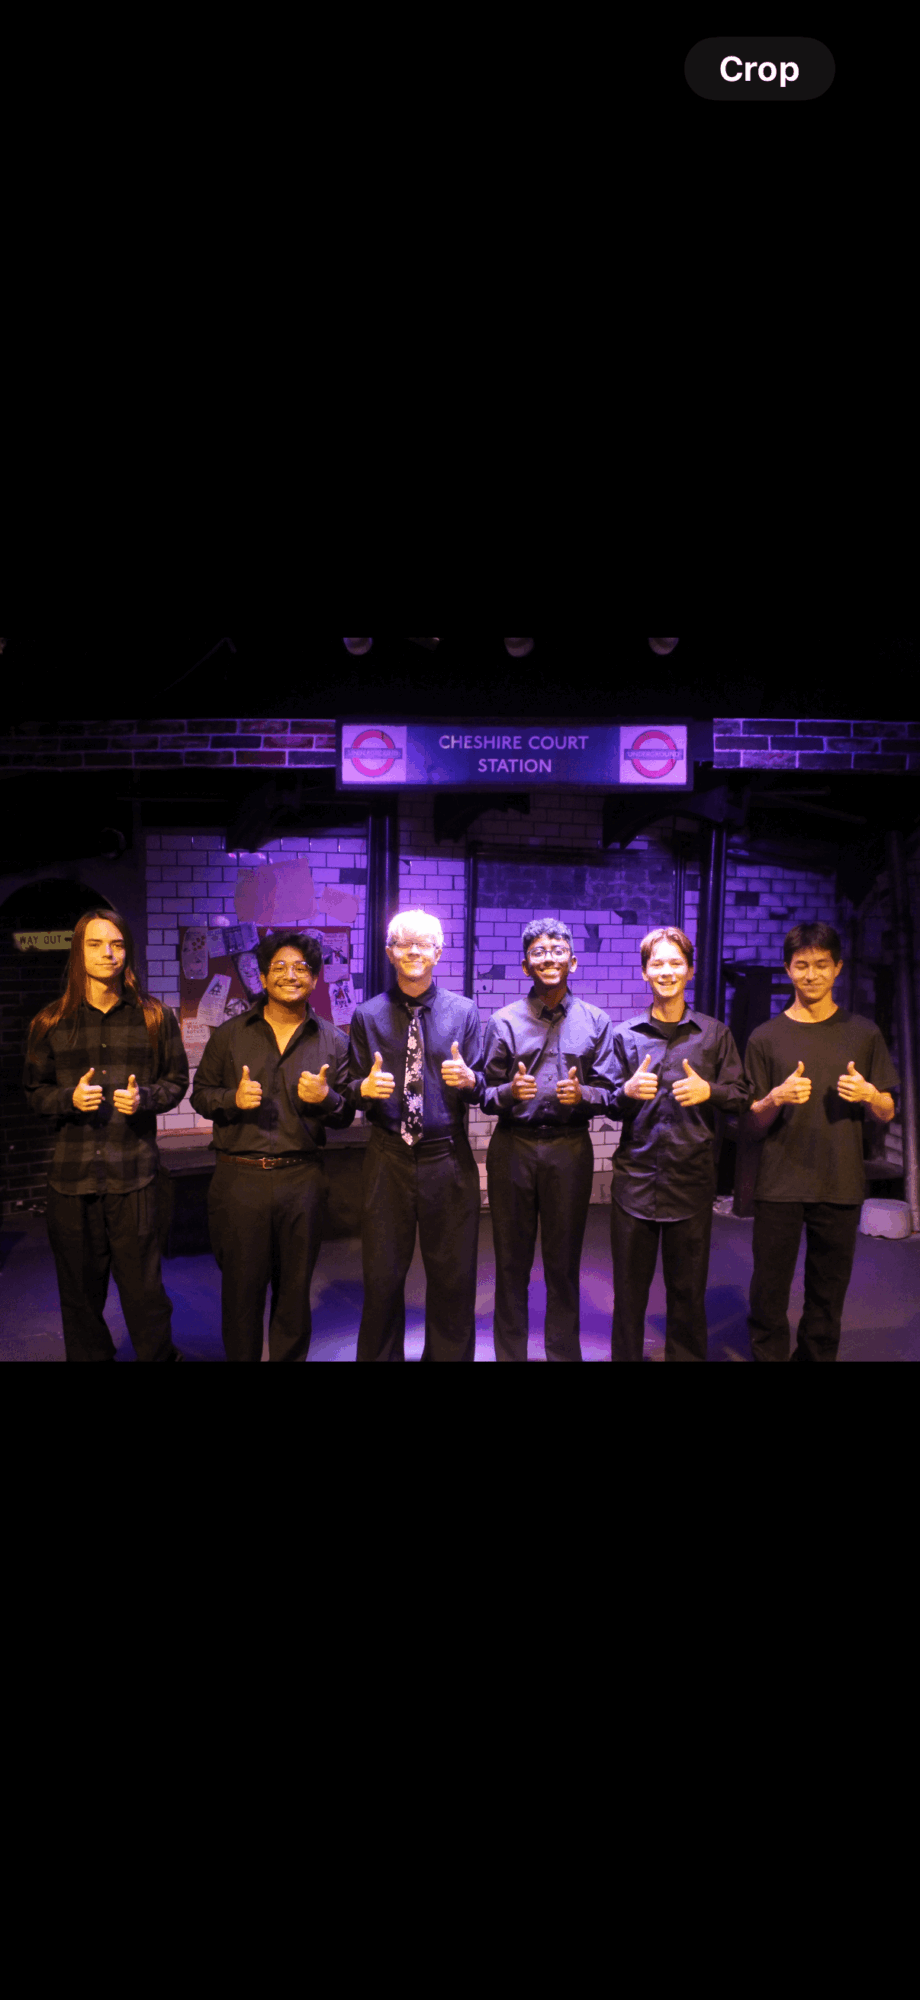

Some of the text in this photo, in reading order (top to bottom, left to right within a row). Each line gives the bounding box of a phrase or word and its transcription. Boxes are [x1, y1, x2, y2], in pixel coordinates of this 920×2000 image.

[438, 735, 590, 750] CHESHIRE COURT
[477, 758, 552, 773] STATION
[20, 935, 61, 945] WAY OUT
